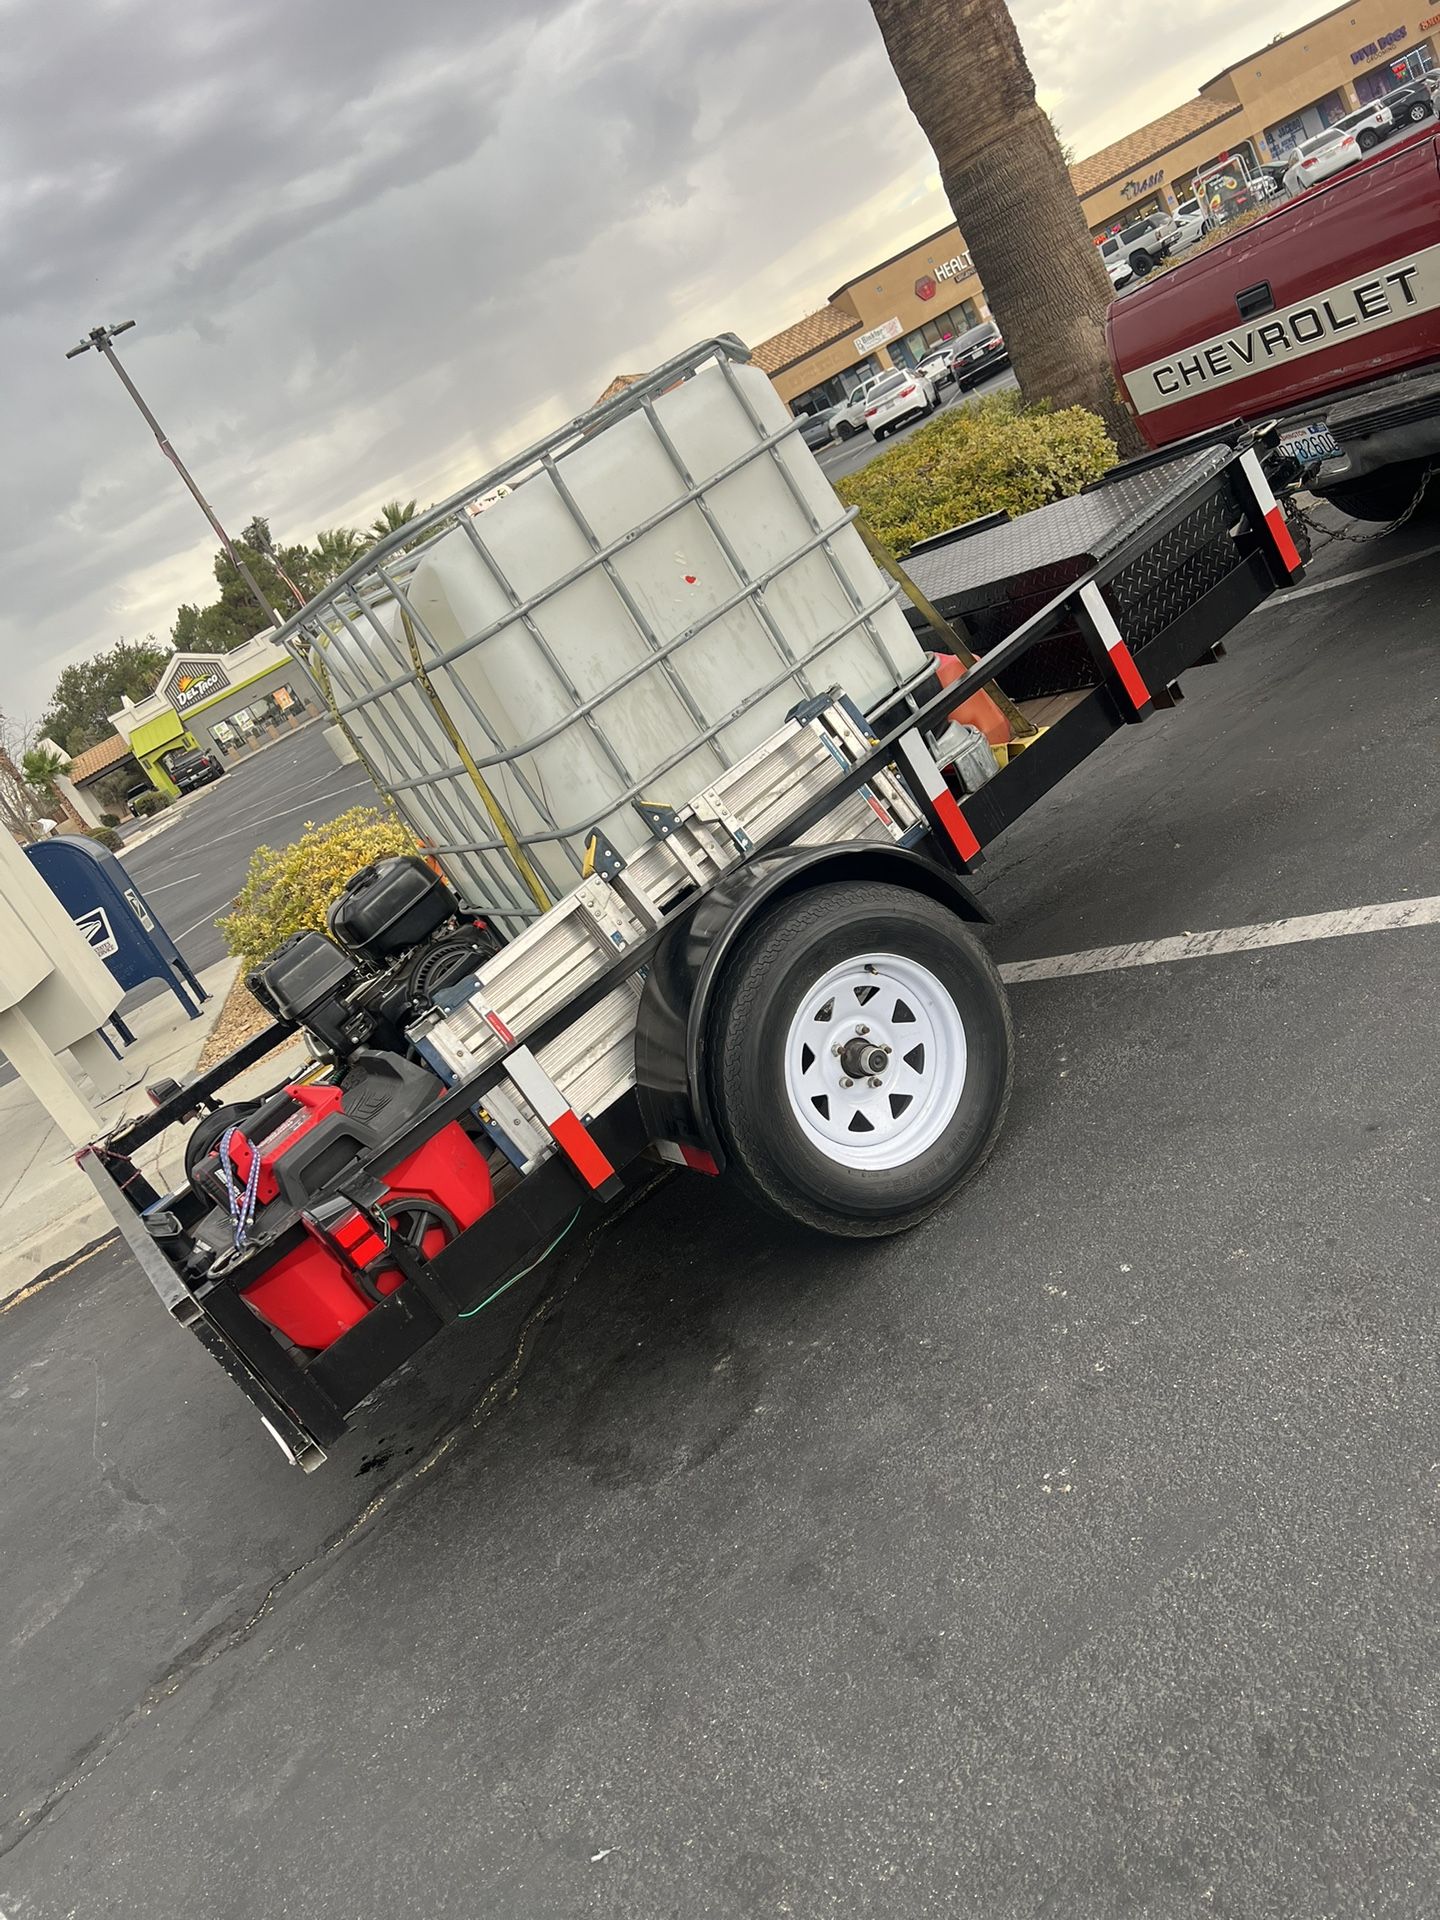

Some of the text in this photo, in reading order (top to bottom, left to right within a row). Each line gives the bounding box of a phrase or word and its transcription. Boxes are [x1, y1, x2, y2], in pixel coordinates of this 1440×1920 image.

[1350, 25, 1408, 65] DIVA DOGS
[1366, 44, 1397, 64] GROOMING
[933, 250, 973, 283] HEALT
[1152, 264, 1418, 397] CHEVROLET
[176, 674, 218, 706] DEL TACO
